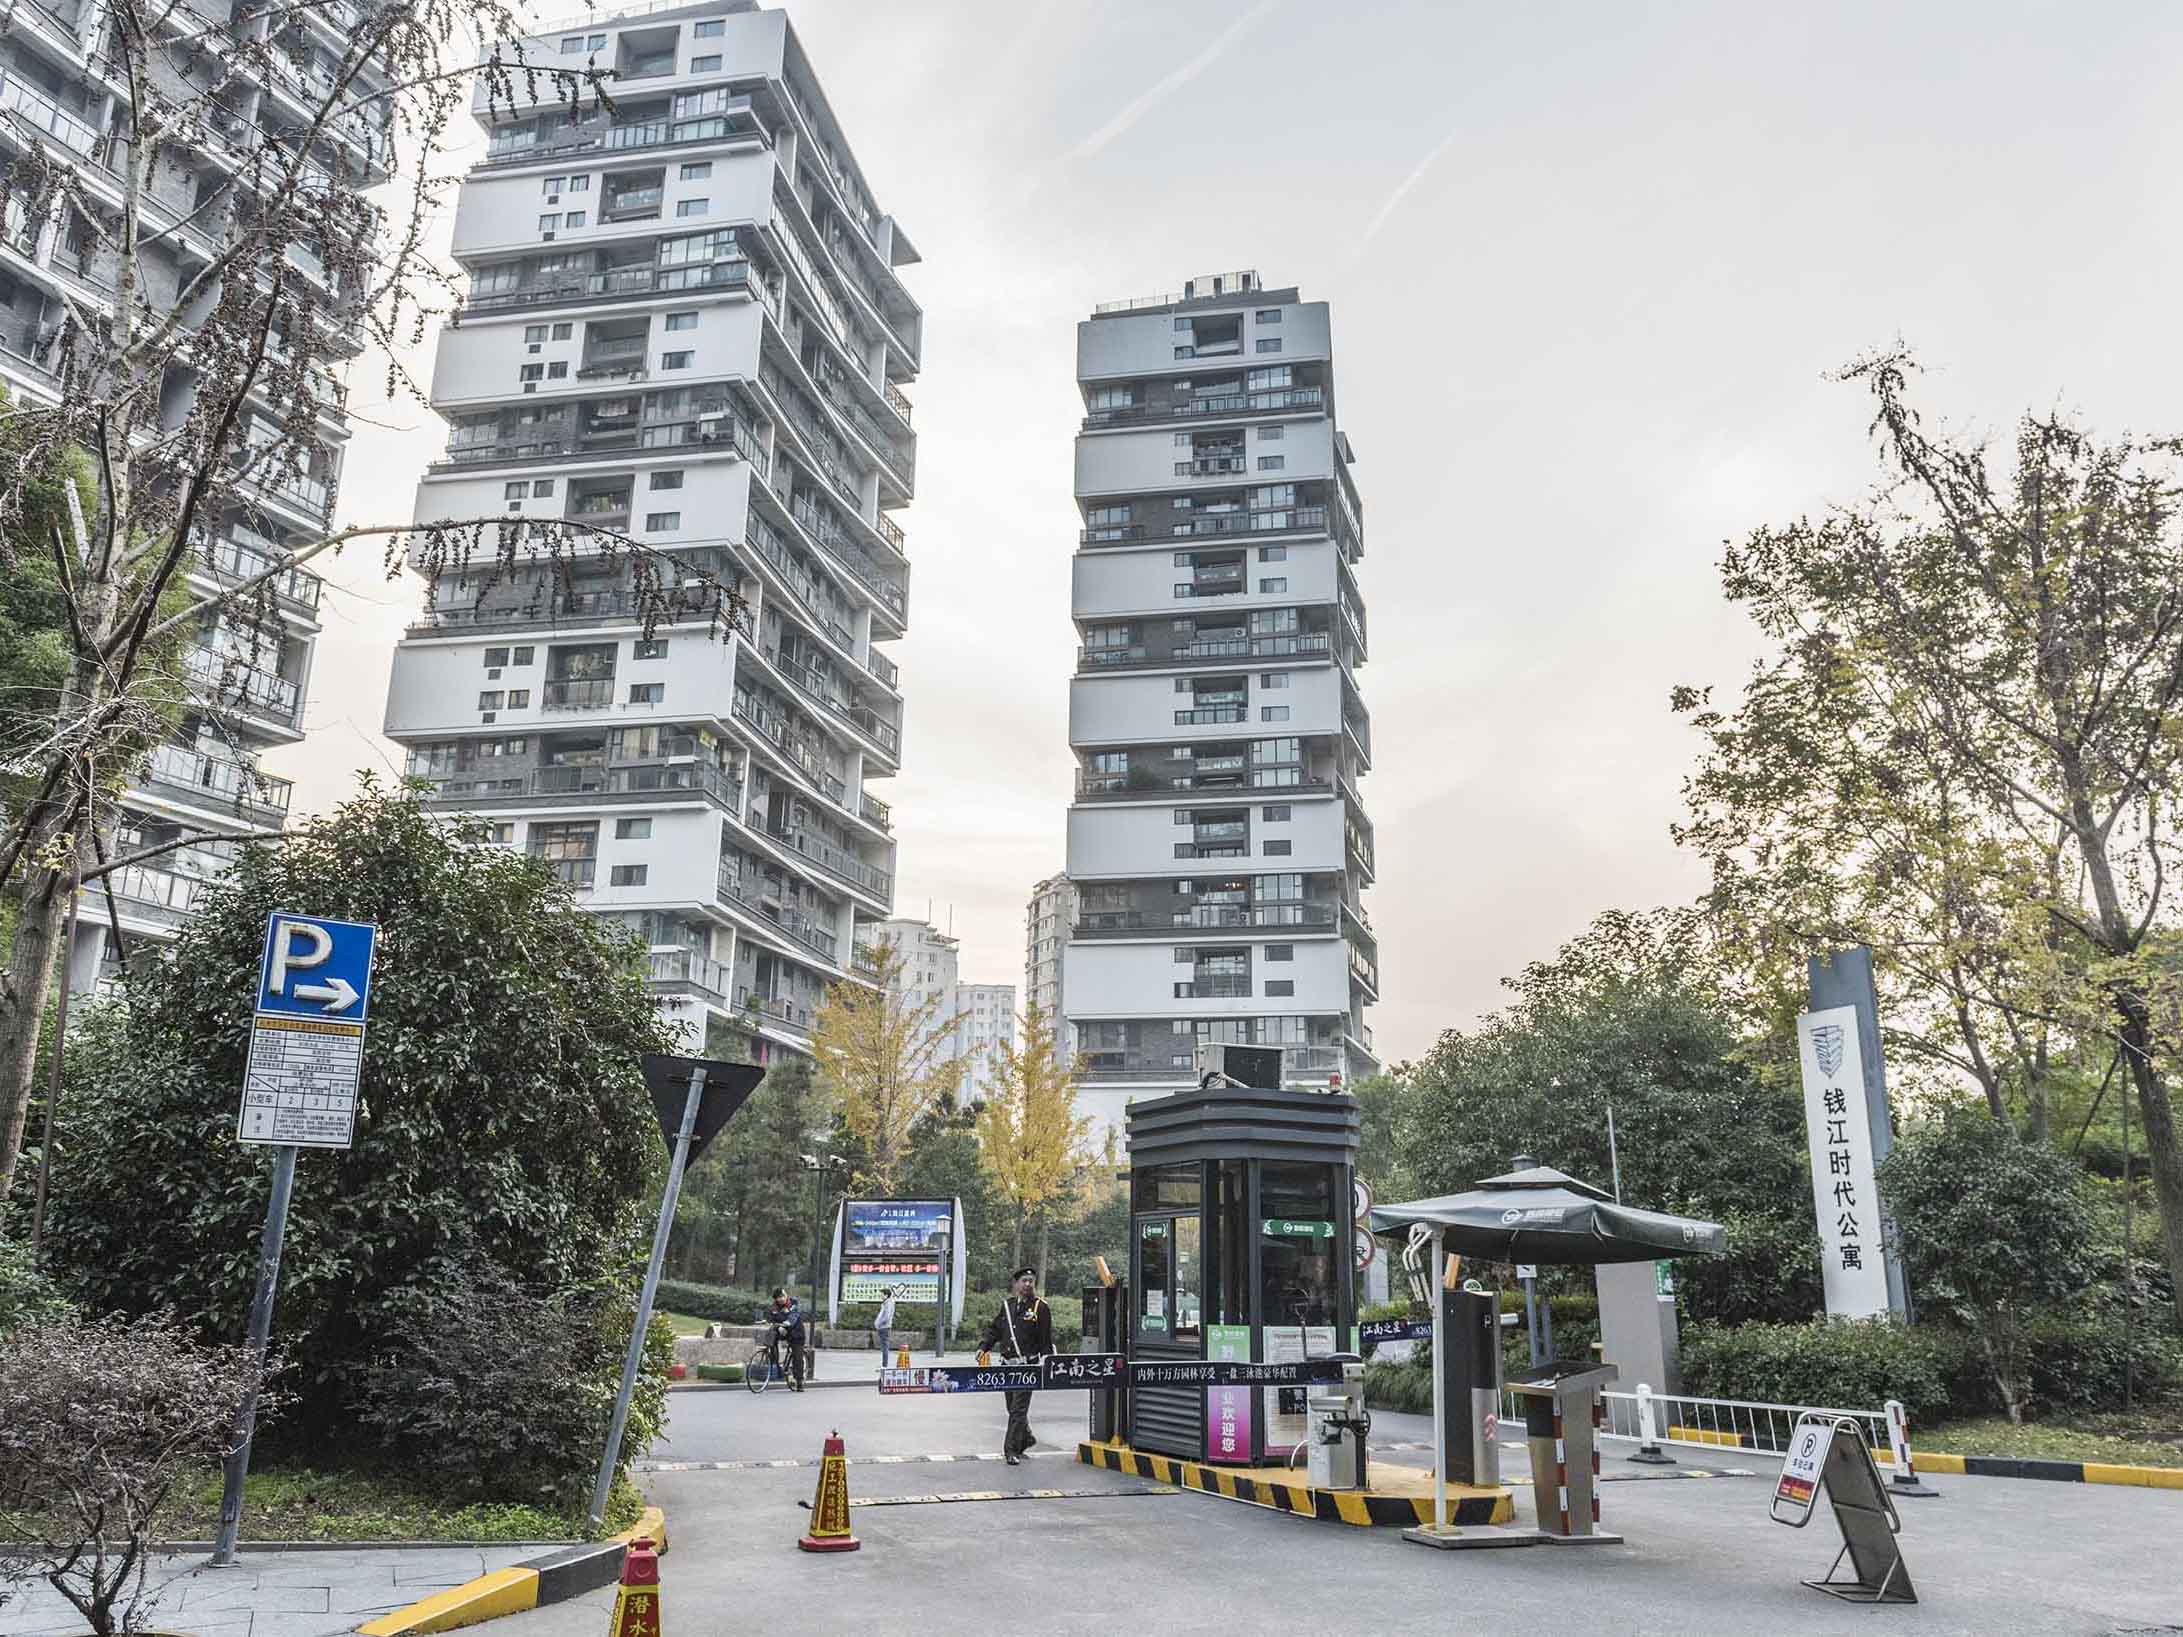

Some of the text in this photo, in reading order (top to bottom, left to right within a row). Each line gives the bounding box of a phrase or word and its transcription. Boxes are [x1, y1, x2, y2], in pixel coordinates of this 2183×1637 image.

[268, 919, 334, 996] P
[1823, 1087, 1862, 1271] 钱江时代公寓
[1362, 1320, 1401, 1337] 江南之星
[977, 1371, 1037, 1386] 8263 7766
[1050, 1357, 1116, 1380] 江南之星
